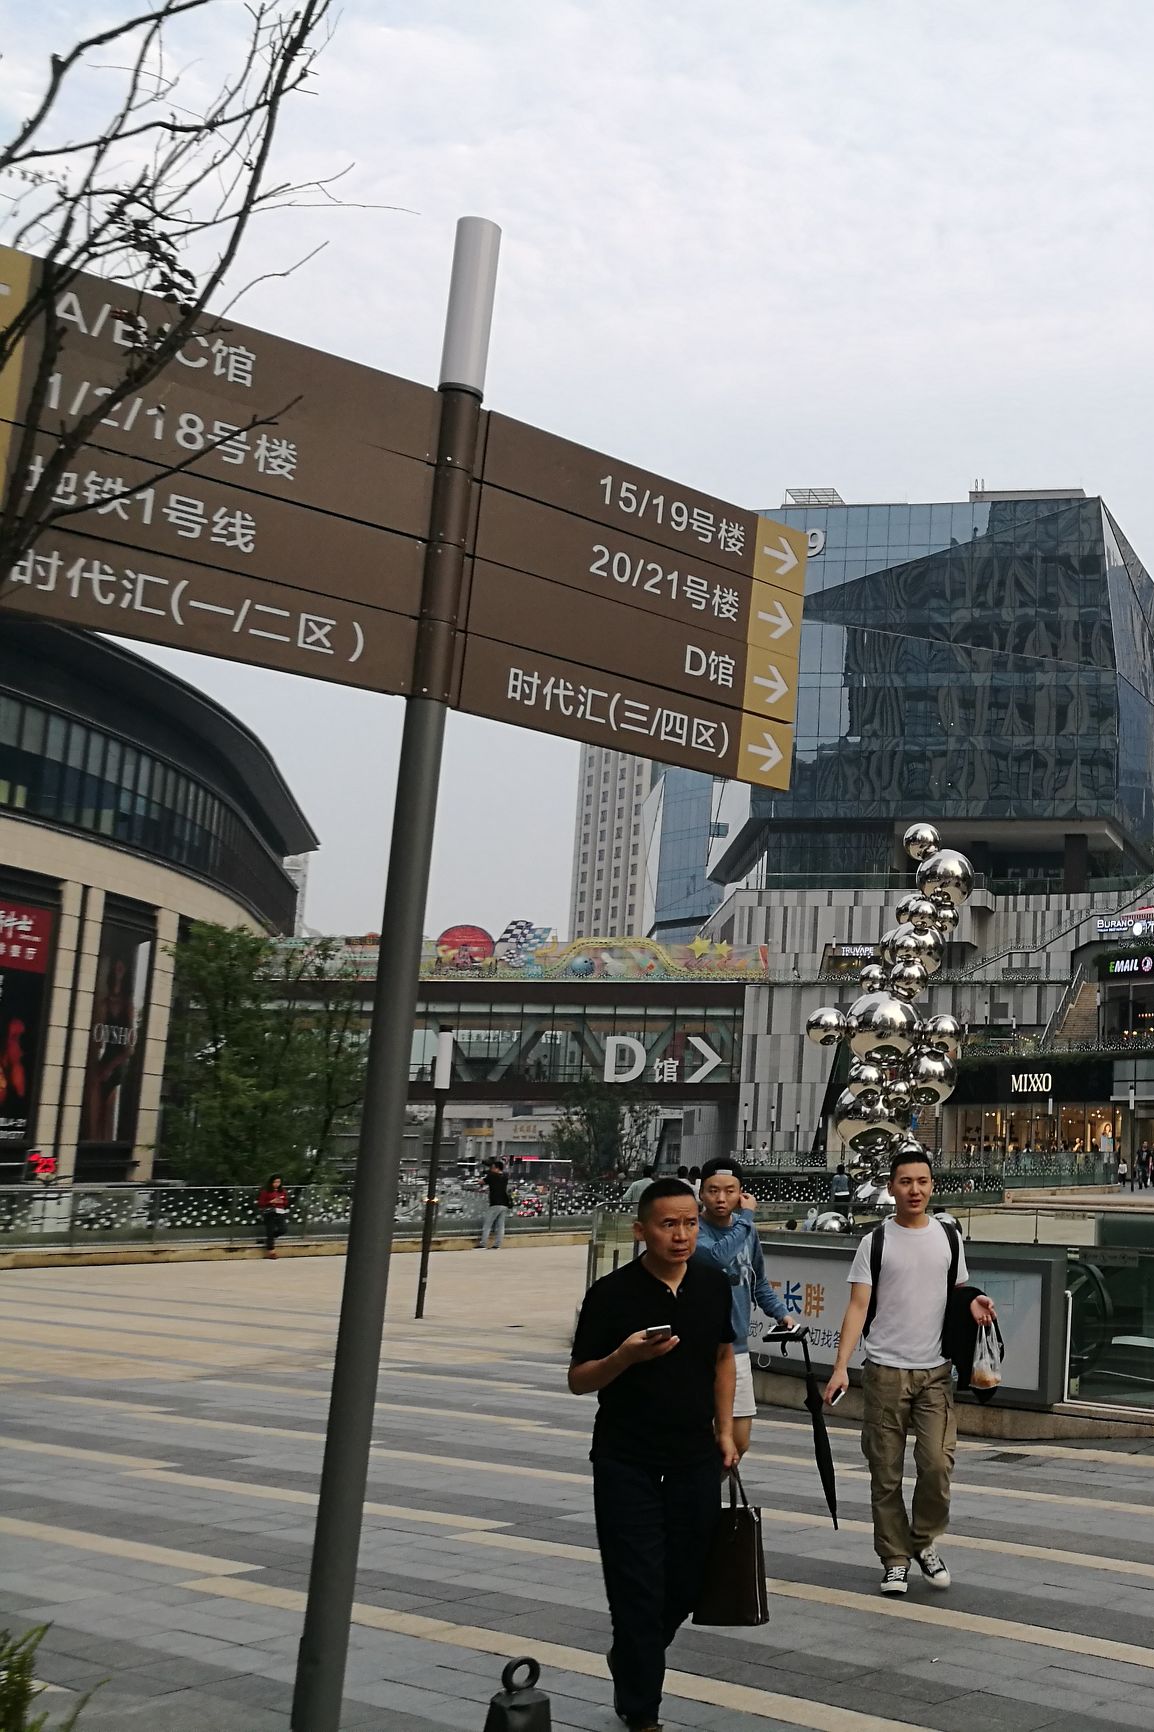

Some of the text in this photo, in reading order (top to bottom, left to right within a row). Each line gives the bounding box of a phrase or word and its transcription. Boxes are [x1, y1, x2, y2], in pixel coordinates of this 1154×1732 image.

[48, 372, 299, 480] 1/2/18号楼
[25, 455, 256, 552] 地铁1号线
[600, 475, 745, 556] 15/19号楼
[10, 549, 365, 662] 时代汇(一/二区)
[589, 545, 739, 622] 20/21号楼
[685, 644, 735, 689] D馆
[507, 667, 729, 758] 时代汇(三/四区)
[1109, 959, 1139, 973] EMAIL
[94, 1023, 138, 1047] OYSHO
[604, 1036, 680, 1083] D馆
[1011, 1073, 1052, 1093] MIXXO
